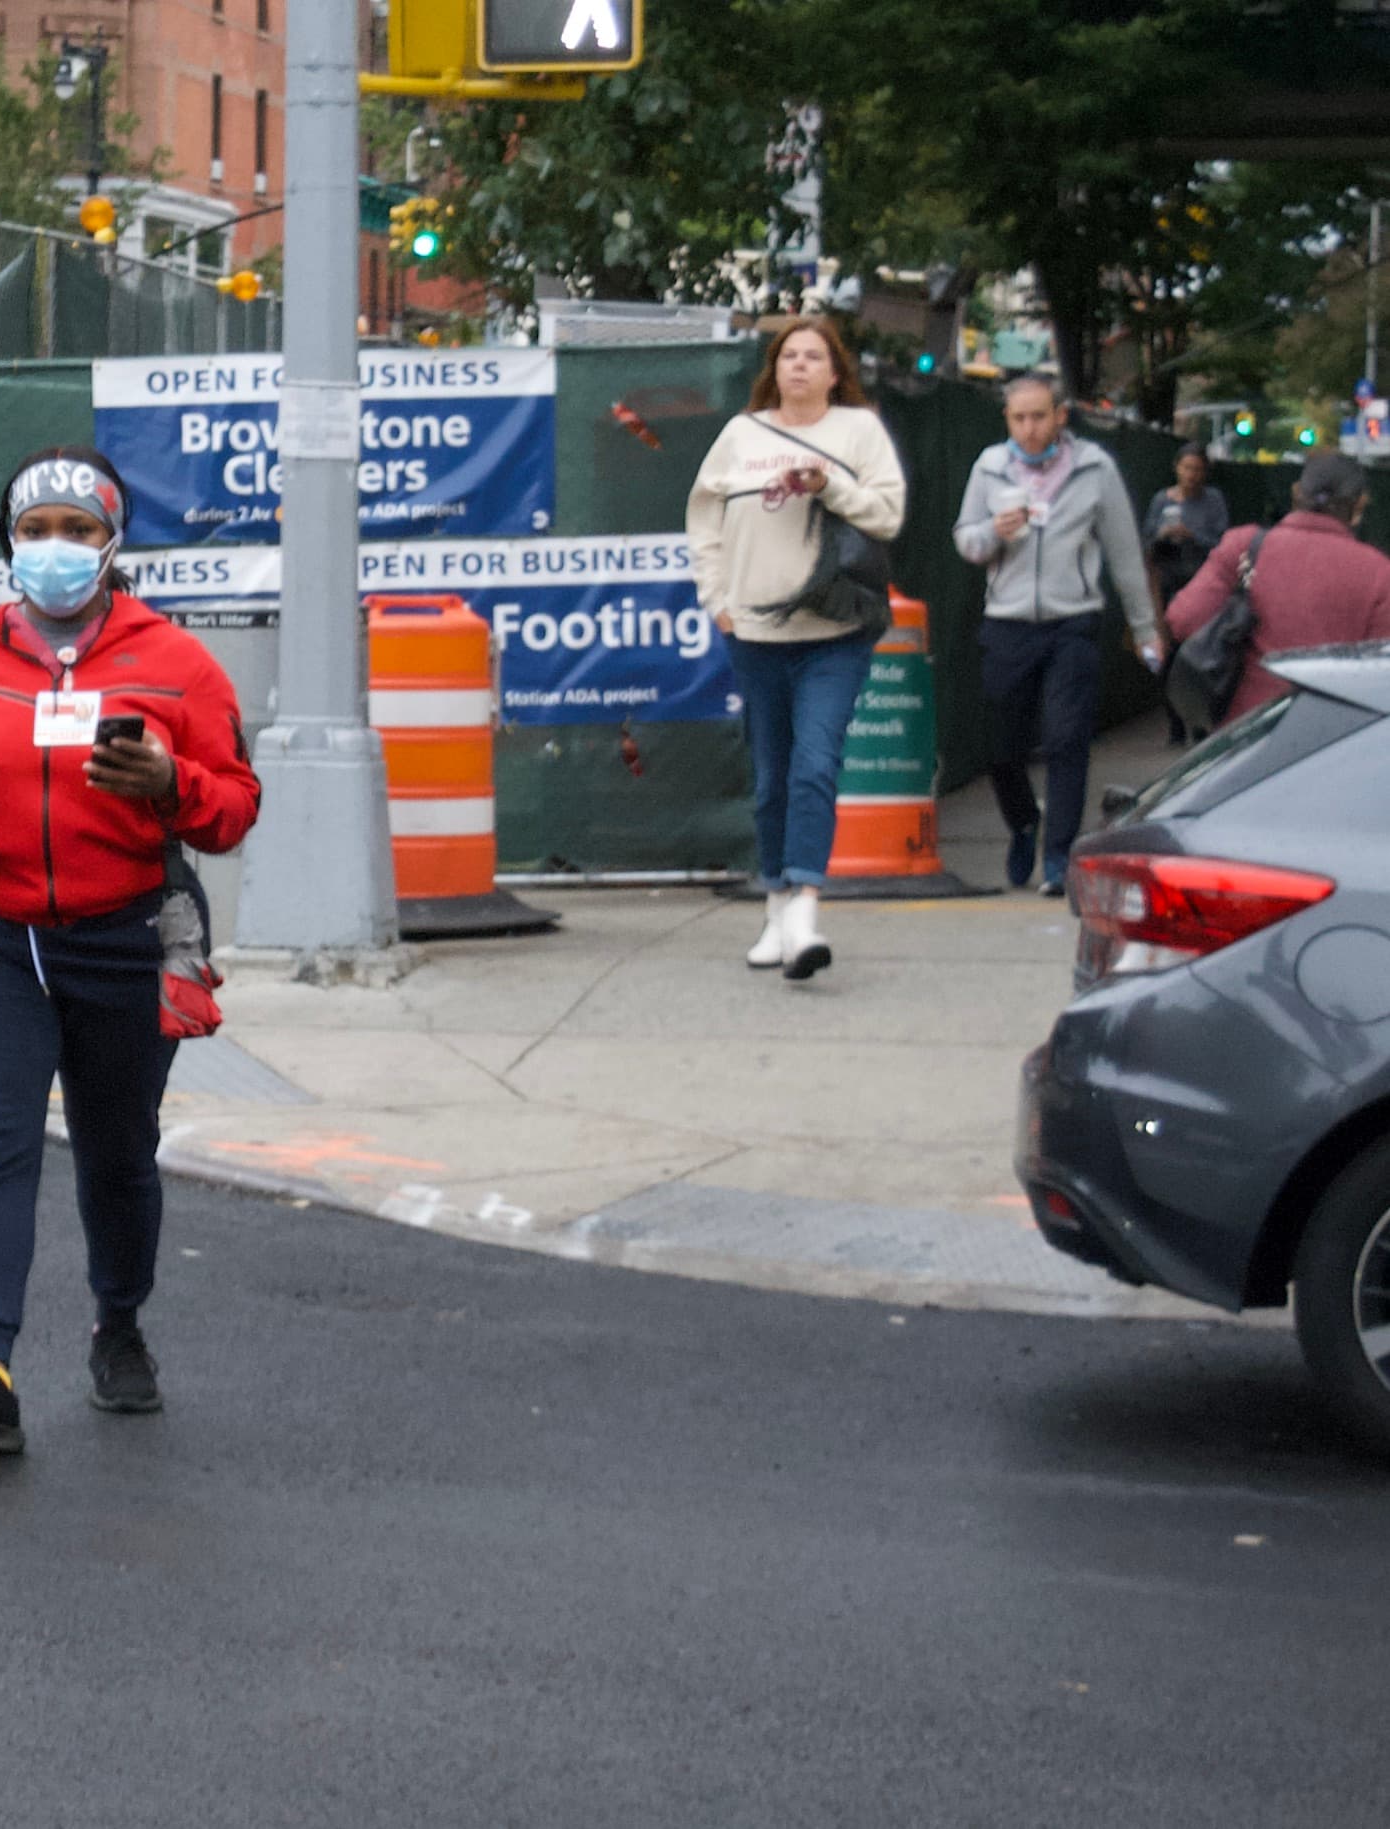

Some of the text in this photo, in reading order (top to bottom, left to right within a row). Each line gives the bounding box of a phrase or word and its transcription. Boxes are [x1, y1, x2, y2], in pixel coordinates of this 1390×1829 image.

[147, 368, 236, 394] OPEN
[360, 361, 500, 389] USINESS
[237, 505, 250, 522] 2
[250, 505, 272, 521] Av
[371, 502, 409, 519] ADA
[411, 502, 466, 521] project
[122, 559, 231, 586] INESS
[361, 545, 690, 577] PEN FOR BUSINESS
[492, 597, 711, 658] Footing
[504, 686, 659, 706] Station ADA project
